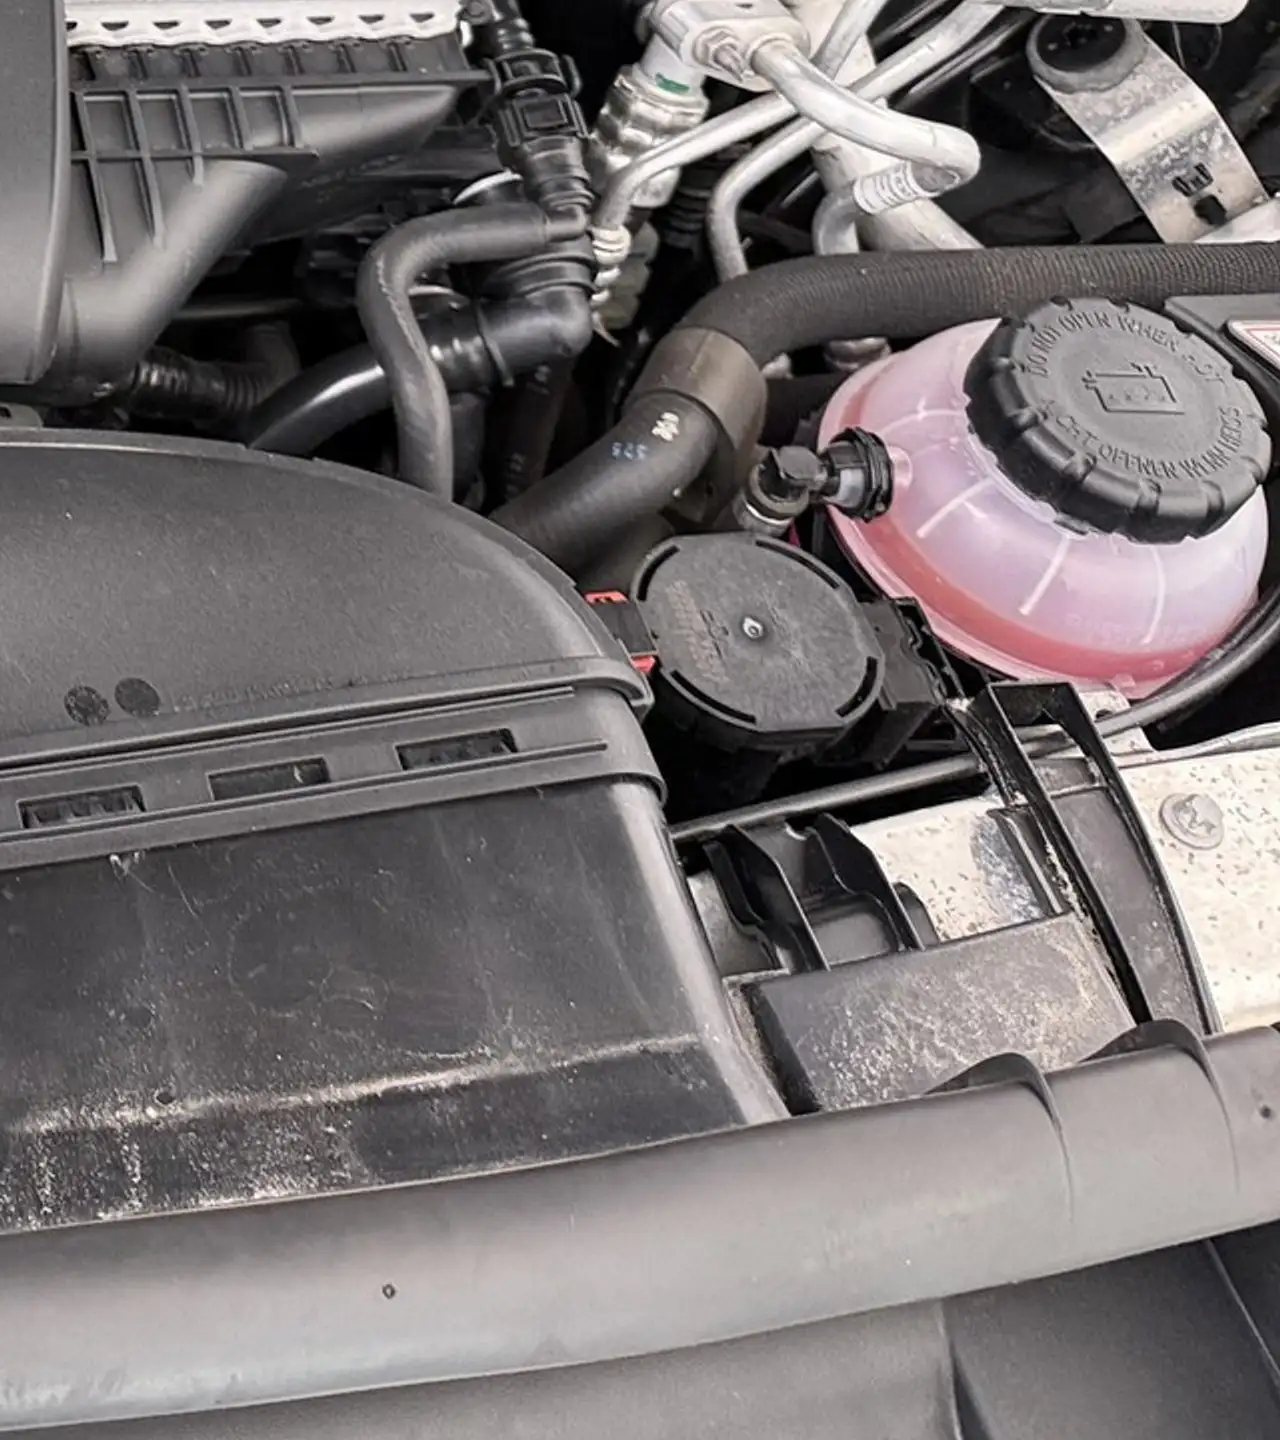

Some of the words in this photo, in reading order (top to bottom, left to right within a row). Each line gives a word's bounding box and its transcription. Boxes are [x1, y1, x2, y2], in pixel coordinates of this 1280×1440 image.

[1057, 310, 1113, 334] OPEN
[1116, 313, 1183, 353] WHEN
[1030, 323, 1063, 355] NOT
[1025, 352, 1050, 379] DO
[1178, 445, 1232, 479] WENN
